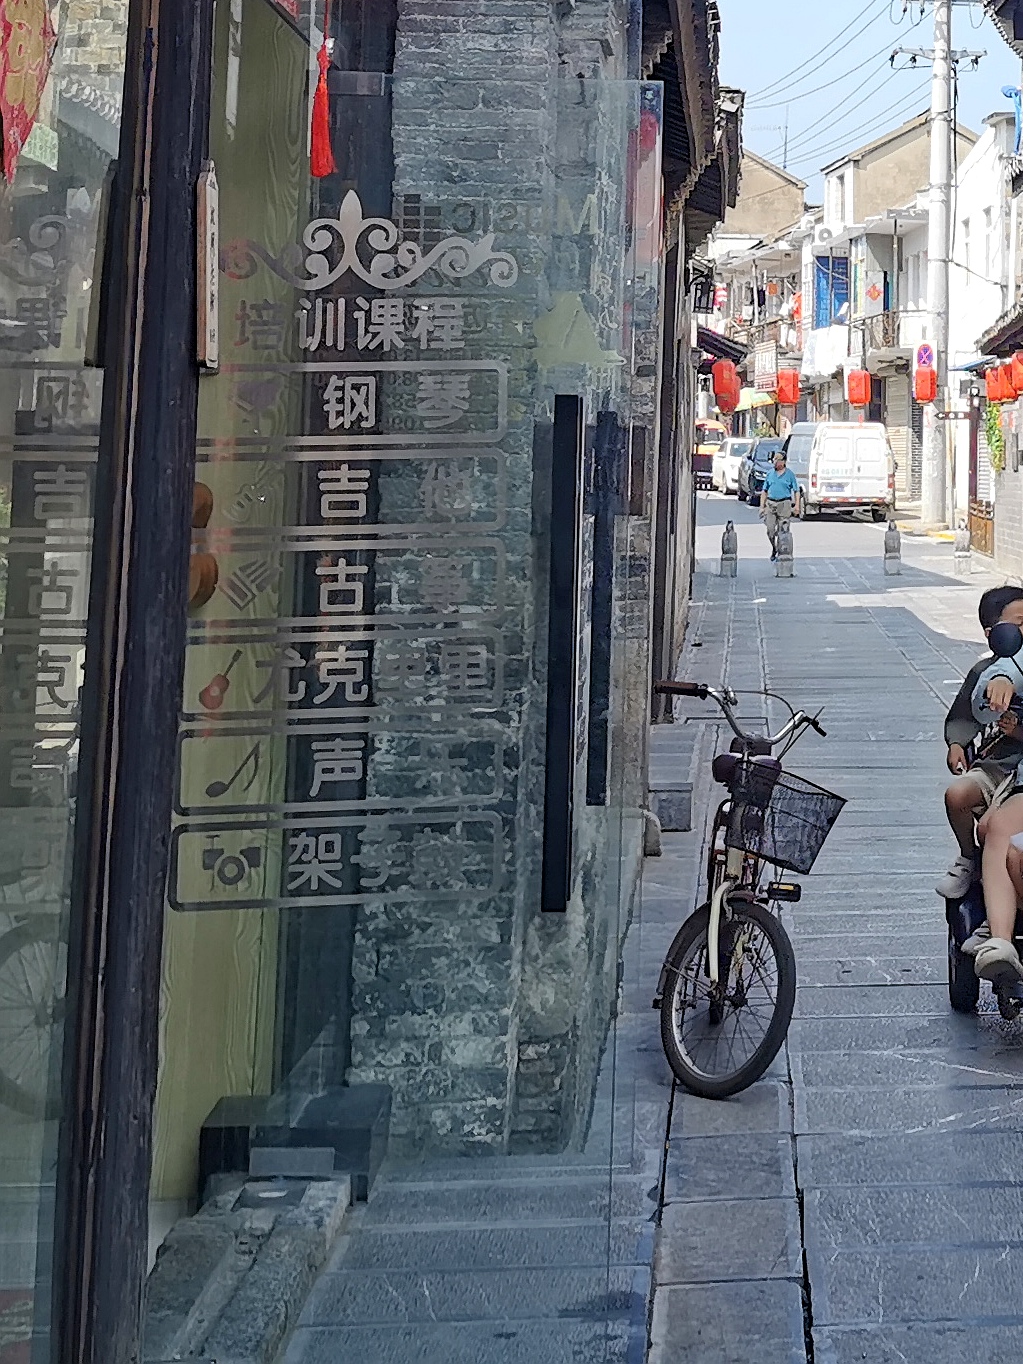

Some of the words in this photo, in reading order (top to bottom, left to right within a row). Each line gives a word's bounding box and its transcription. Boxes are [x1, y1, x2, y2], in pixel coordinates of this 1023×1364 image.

[234, 296, 466, 352] 培训课程
[323, 374, 471, 429] 钢琴
